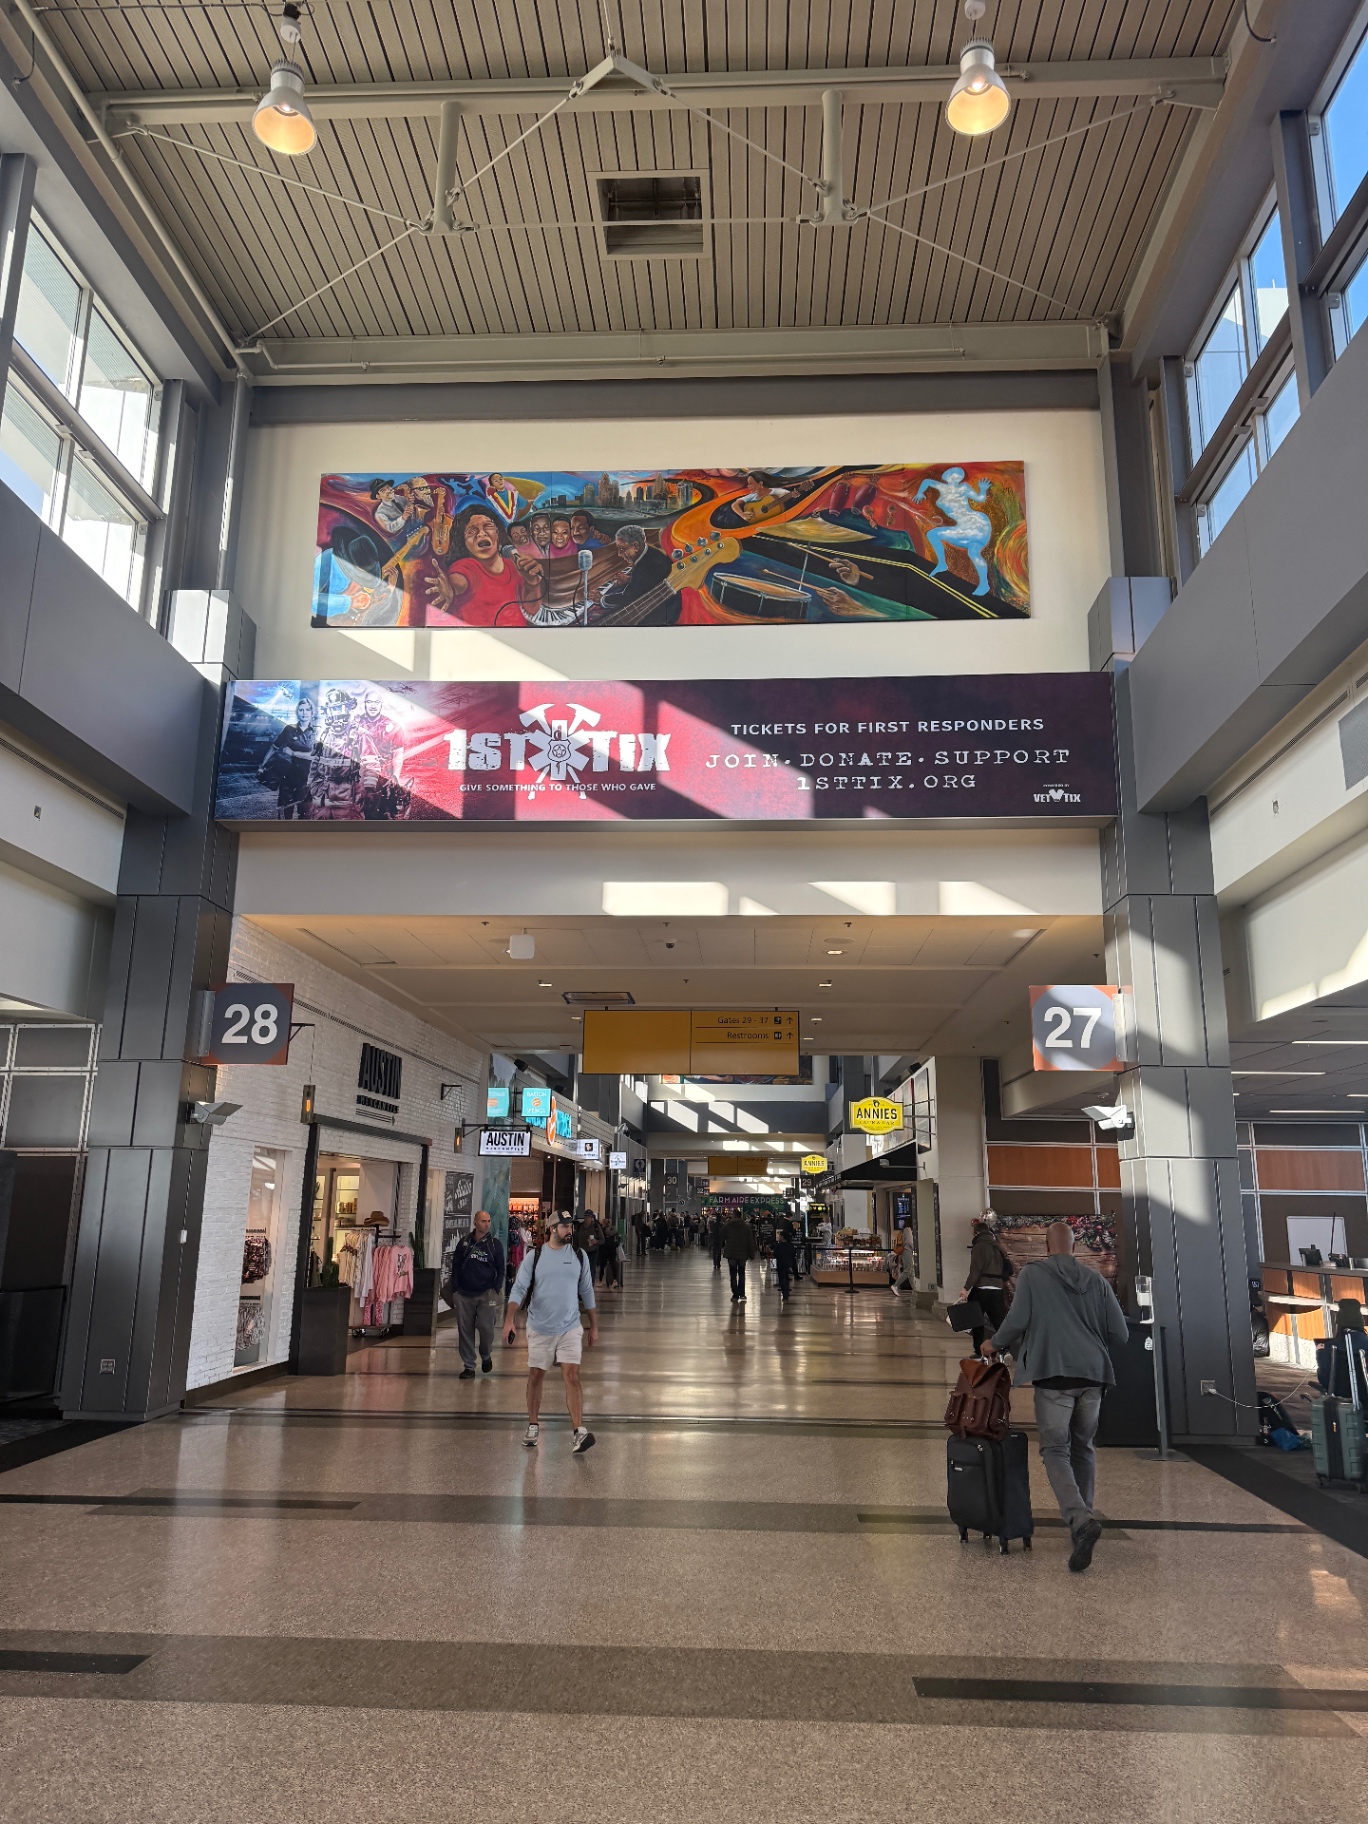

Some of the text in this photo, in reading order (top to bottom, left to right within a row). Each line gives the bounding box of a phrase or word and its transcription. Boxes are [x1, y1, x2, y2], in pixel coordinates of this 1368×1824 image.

[731, 718, 1044, 735] TICKETS FOR FIRST RESPONDERS
[587, 729, 672, 772] TIX
[934, 749, 1070, 765] SUPPORT
[459, 783, 657, 792] GIVE SOMETHING TO THOSE WHO GAVE
[796, 774, 976, 790] 1STTIX.ORG
[221, 1003, 279, 1045] 28
[717, 1016, 740, 1024] Gates
[742, 1016, 752, 1024] 29
[758, 1016, 769, 1024] 37
[1044, 1006, 1102, 1048] 27
[727, 1031, 769, 1039] Restrooms
[357, 1042, 402, 1100] AUSTIN
[356, 1094, 400, 1114] MERCANTILE
[856, 1107, 898, 1119] ANNIES
[486, 1132, 525, 1147] AUSTIN
[667, 1176, 677, 1185] 30
[802, 1178, 812, 1187] 29
[750, 1196, 785, 1205] EXPRESS
